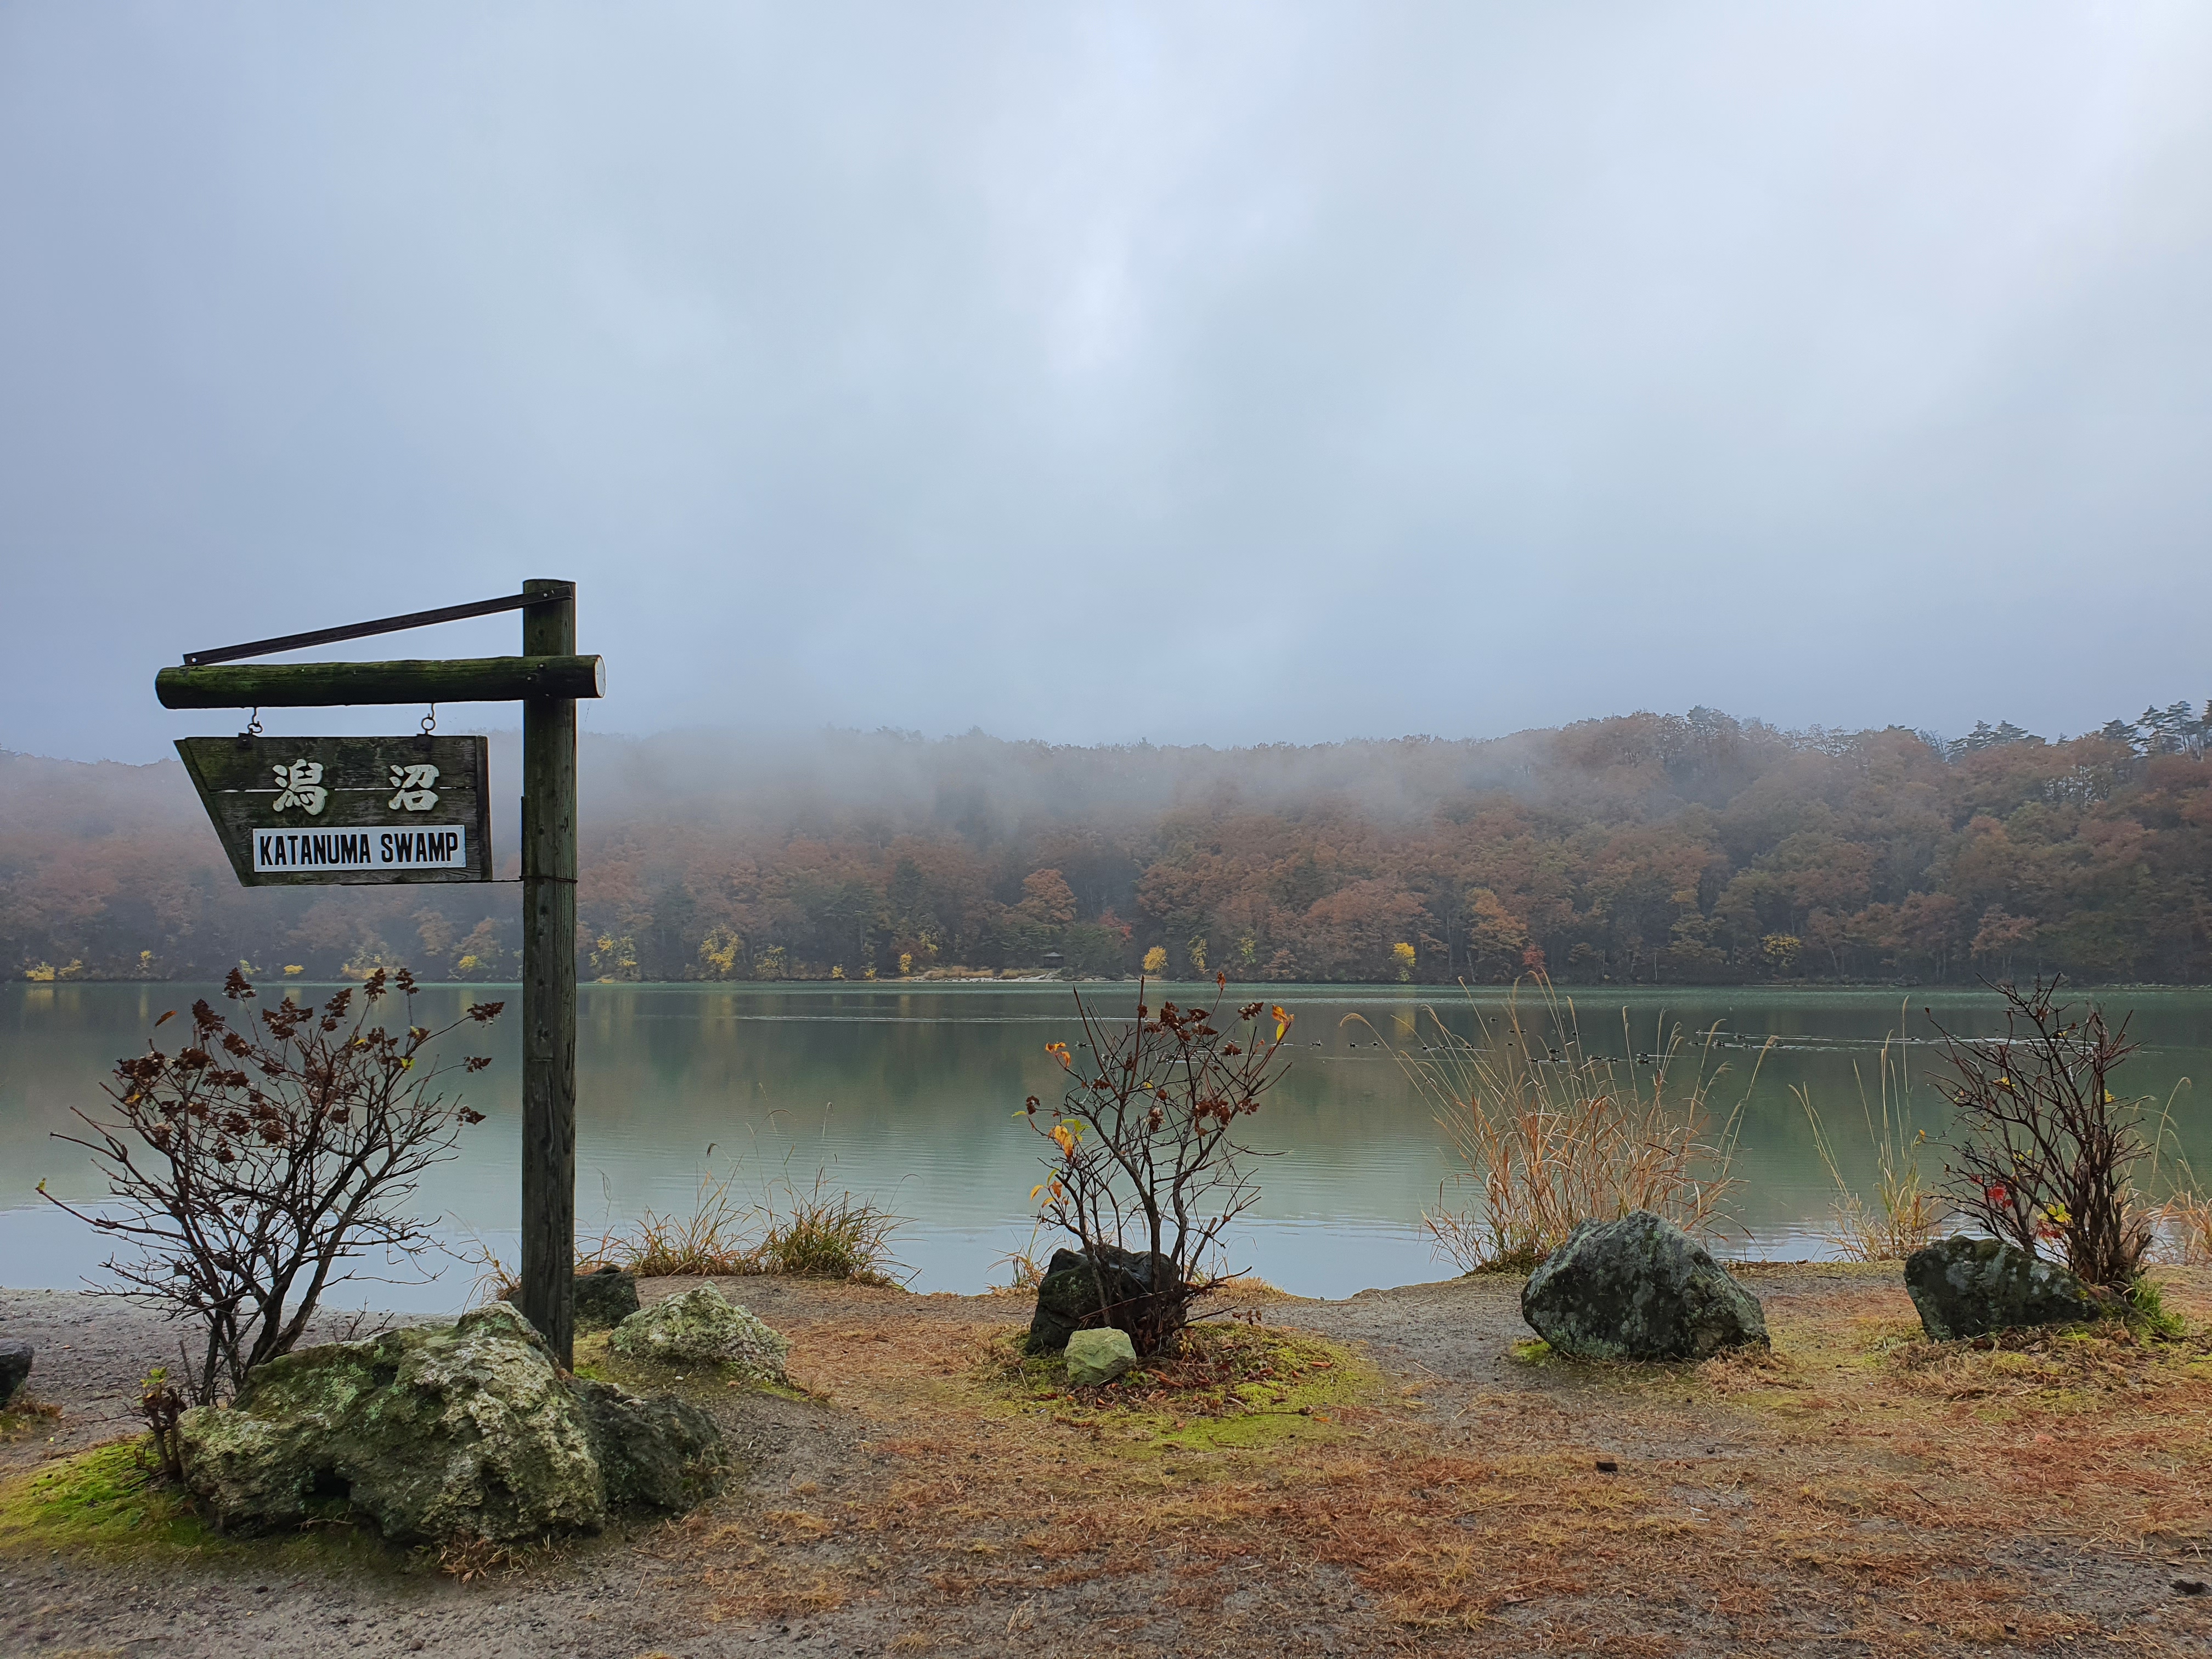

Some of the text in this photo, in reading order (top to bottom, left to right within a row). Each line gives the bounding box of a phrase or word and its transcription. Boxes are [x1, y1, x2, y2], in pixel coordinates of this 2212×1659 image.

[273, 759, 439, 815] 潟沼
[259, 832, 458, 866] KATANUMA SWAMP
